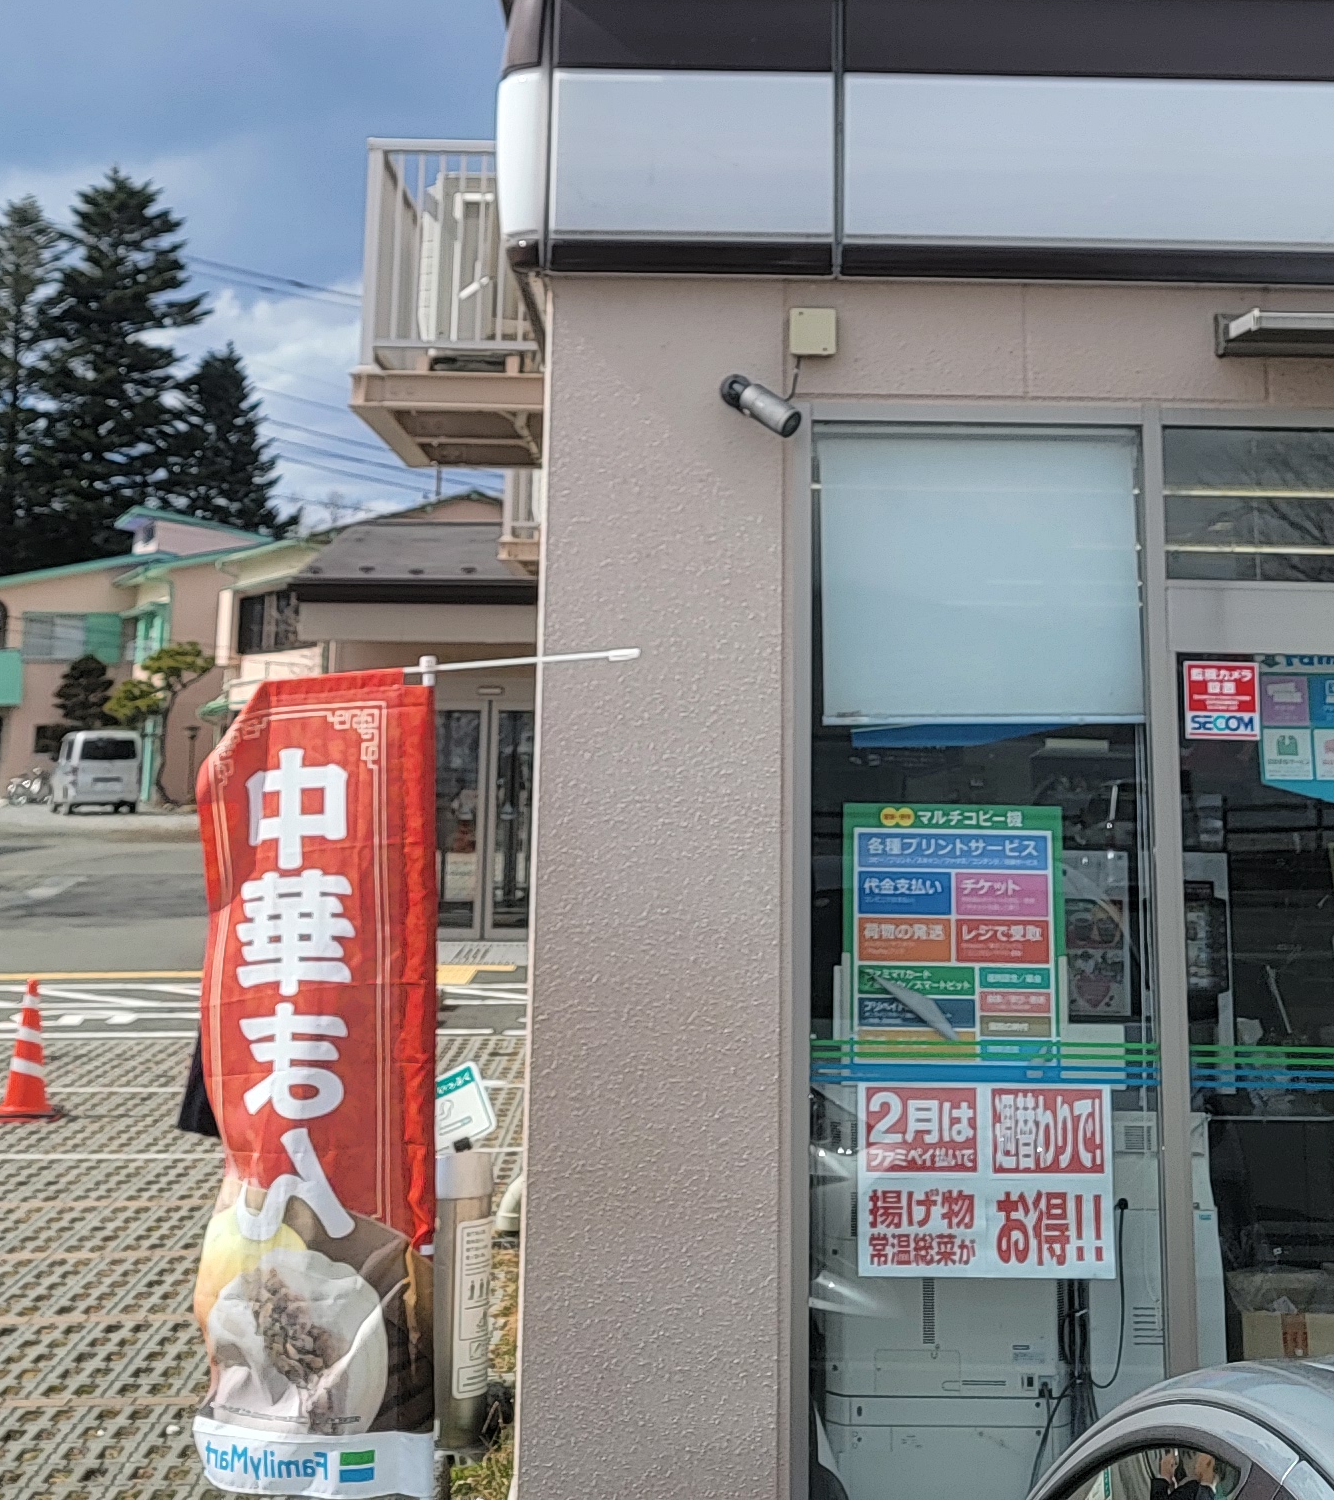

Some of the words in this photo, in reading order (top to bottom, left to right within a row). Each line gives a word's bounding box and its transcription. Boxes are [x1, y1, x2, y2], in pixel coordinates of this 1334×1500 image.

[1190, 715, 1255, 732] SECOM
[917, 810, 1023, 827] マルチコピー機
[867, 837, 1038, 857] 各種プリントサービス
[864, 878, 943, 894] 代金支払い
[961, 879, 1021, 896] チケット
[869, 1091, 975, 1143] 2月は
[995, 1092, 1102, 1170] 週替わりで!
[869, 1148, 975, 1167] ファミペイ払いで
[869, 1188, 975, 1229] 揚げ物
[996, 1190, 1103, 1266] お得!!
